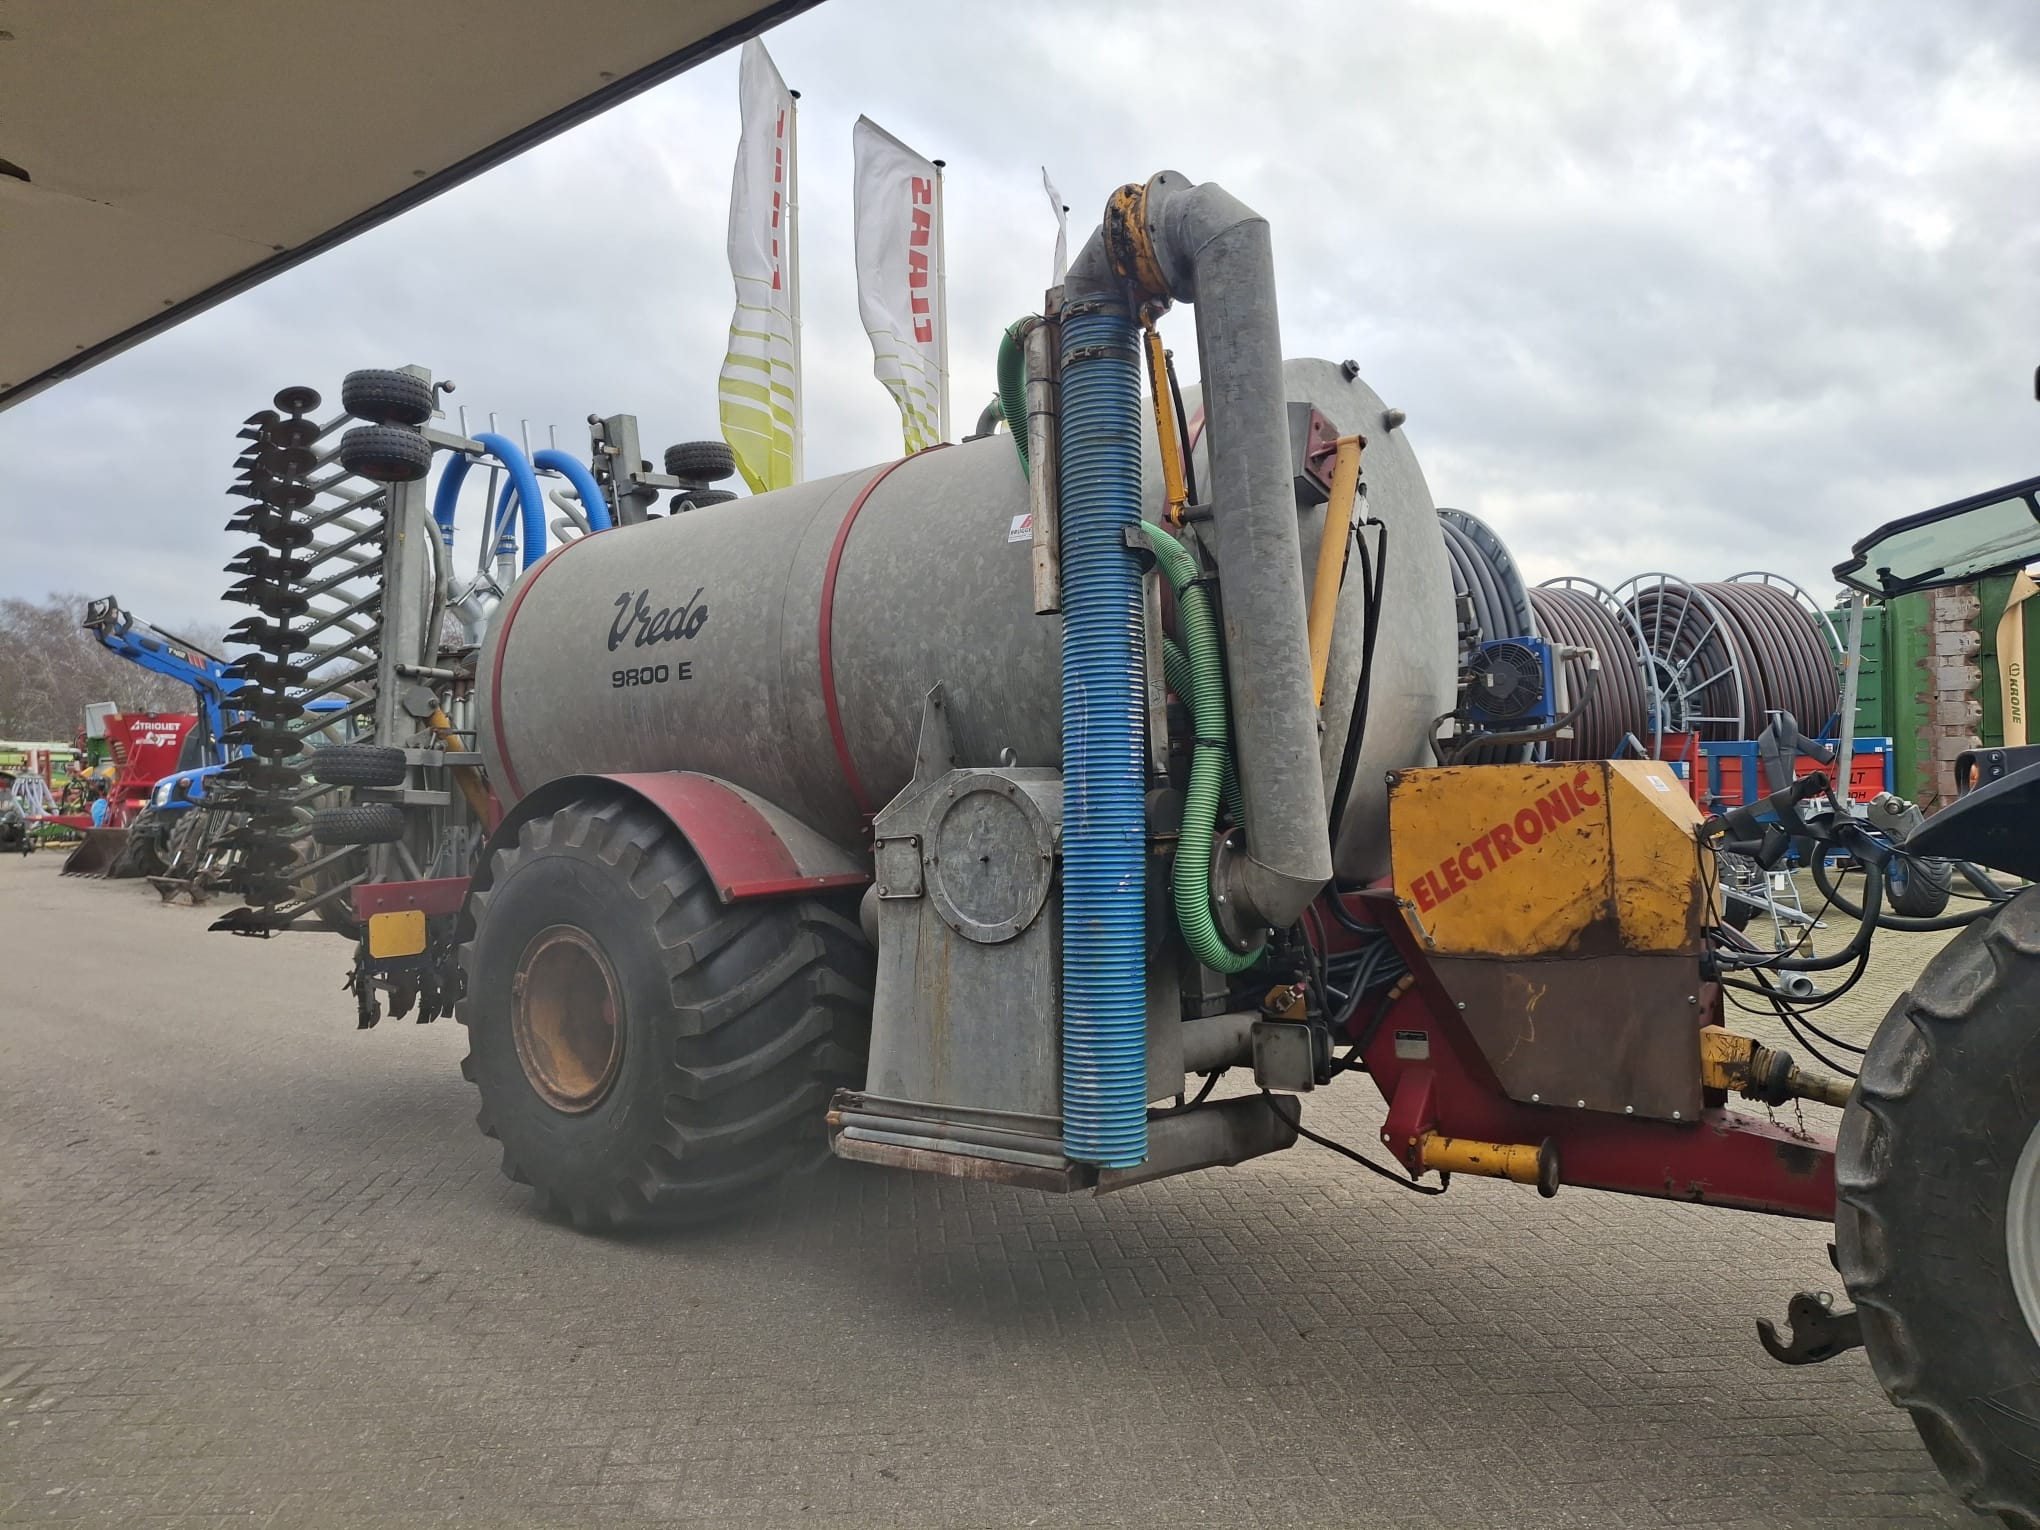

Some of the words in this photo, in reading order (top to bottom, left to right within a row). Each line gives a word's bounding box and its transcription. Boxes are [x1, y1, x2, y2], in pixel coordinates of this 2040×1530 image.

[608, 587, 709, 652] Vredo
[612, 665, 669, 688] 9800
[678, 661, 693, 681] E
[2009, 679, 2022, 724] KRONE
[1410, 770, 1601, 913] ELECTRONIC
